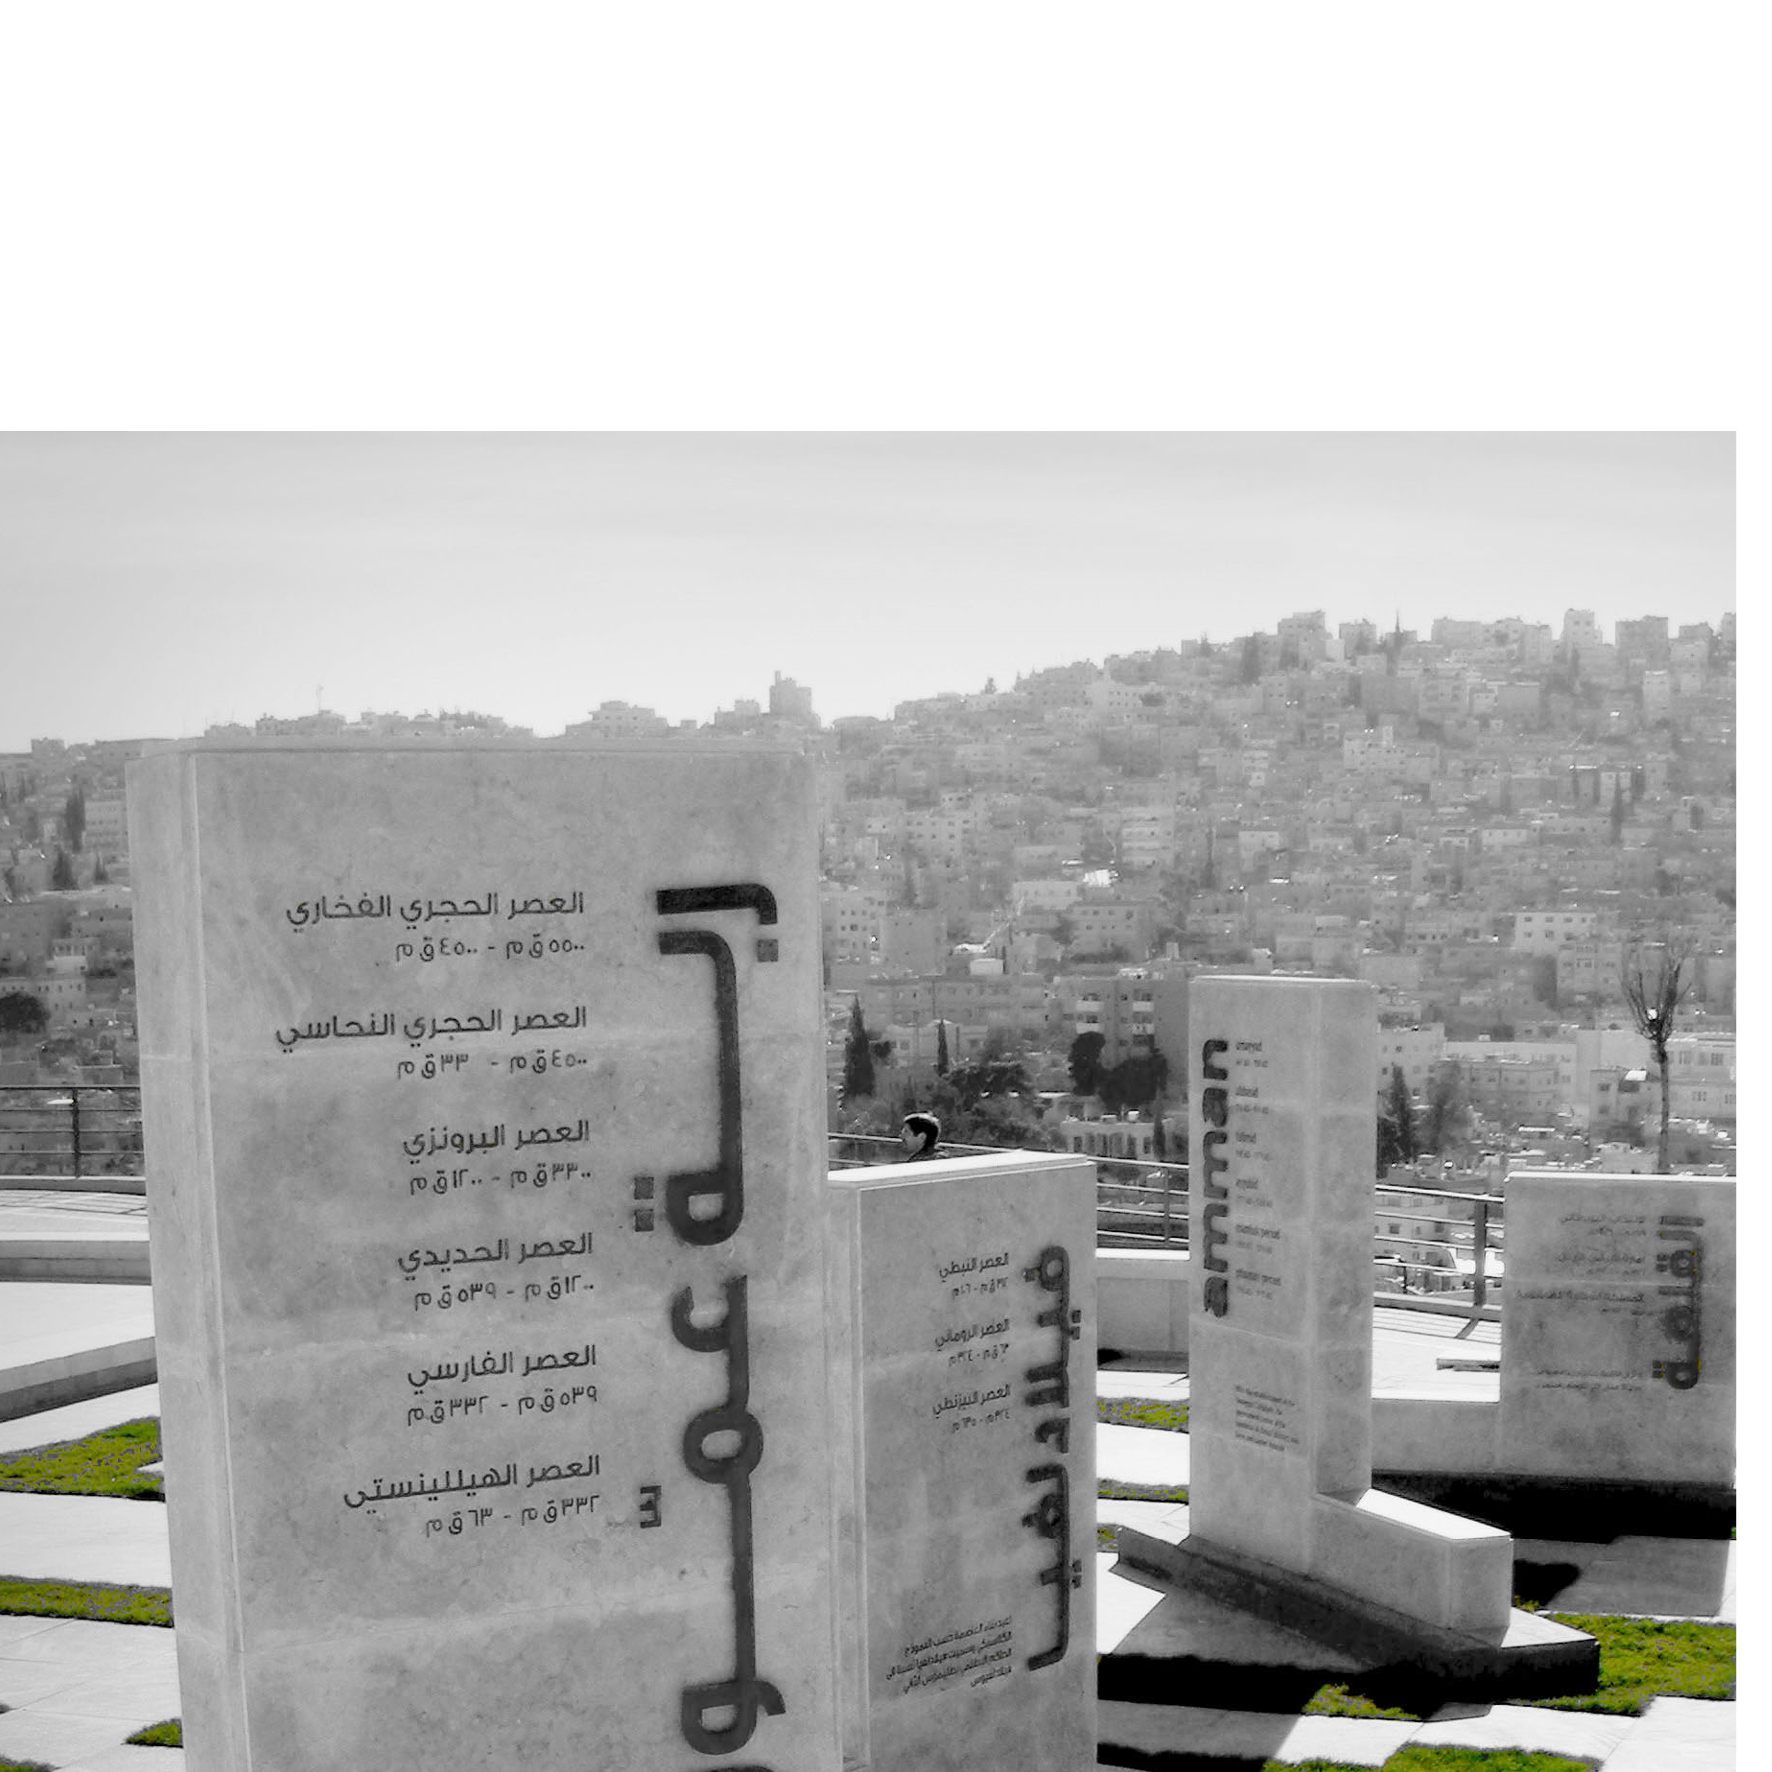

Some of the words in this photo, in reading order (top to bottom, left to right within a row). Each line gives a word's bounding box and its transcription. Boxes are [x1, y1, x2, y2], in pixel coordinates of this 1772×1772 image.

[286, 892, 391, 934] الفخاري
[400, 893, 498, 930] الحجري
[508, 892, 584, 920] العصر
[276, 1014, 395, 1053] النحاسي
[404, 1010, 501, 1047] الحجري
[511, 1007, 587, 1035] العصر
[403, 1124, 504, 1164] البرونزي
[515, 1120, 589, 1149] العصر
[1202, 1038, 1229, 1318] amman
[398, 1238, 509, 1281] الحديدي
[518, 1233, 592, 1263] العصر
[407, 1350, 513, 1395] الفارسي
[522, 1345, 596, 1376] العصر
[527, 1455, 600, 1487] العصر
